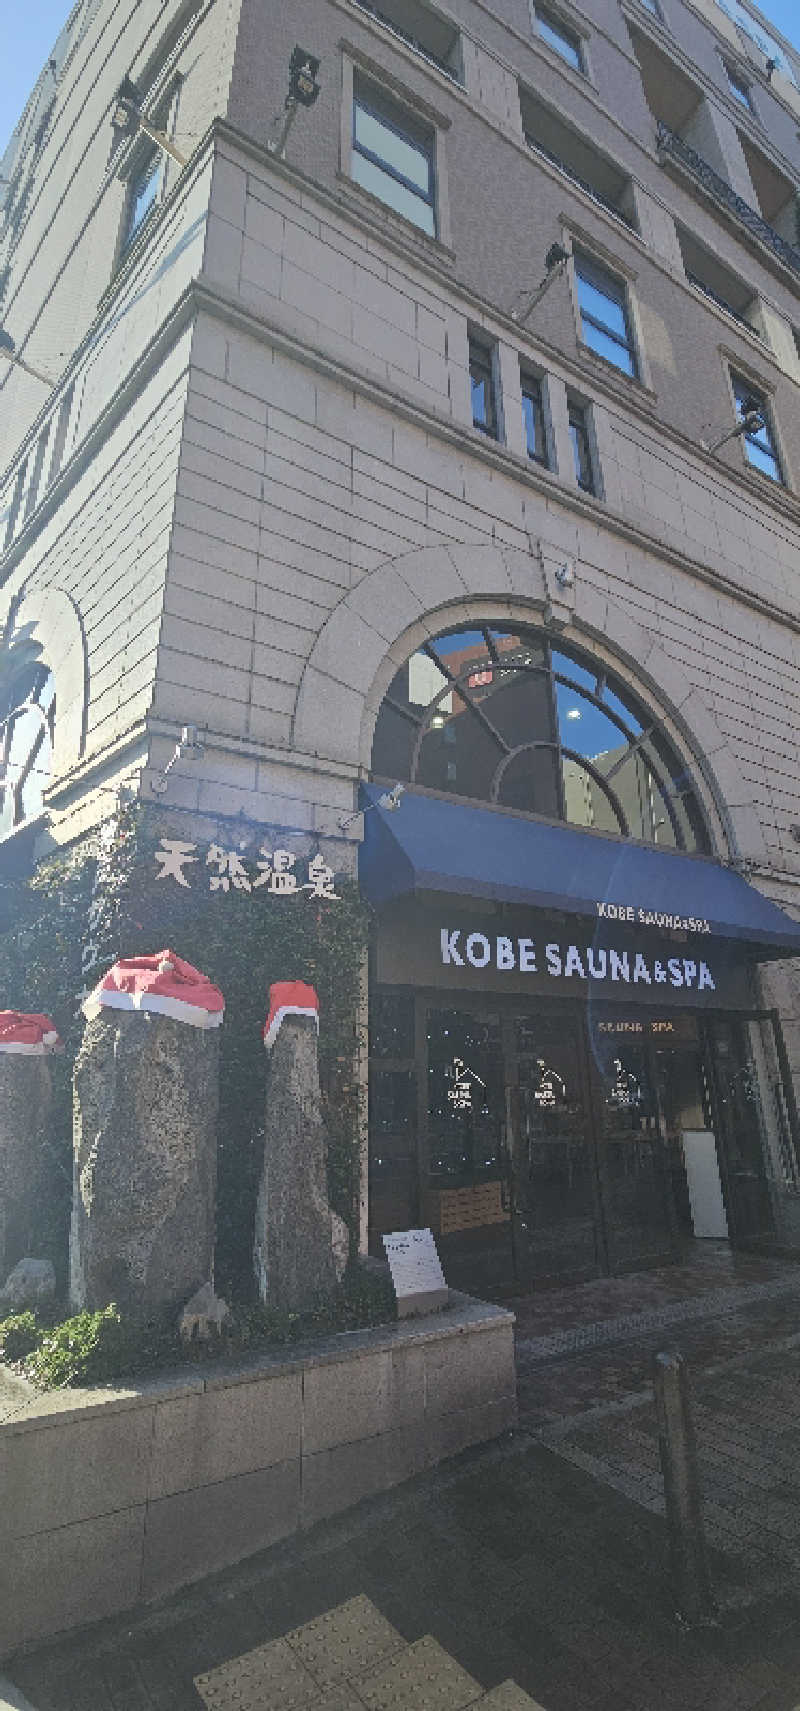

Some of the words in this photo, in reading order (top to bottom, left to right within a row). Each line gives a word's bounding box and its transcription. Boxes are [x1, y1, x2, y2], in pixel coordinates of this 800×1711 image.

[154, 838, 342, 899] 天然温泉
[596, 902, 635, 921] KOBE
[440, 928, 538, 972] KOBE
[545, 943, 716, 990] SAUNA&SPA
